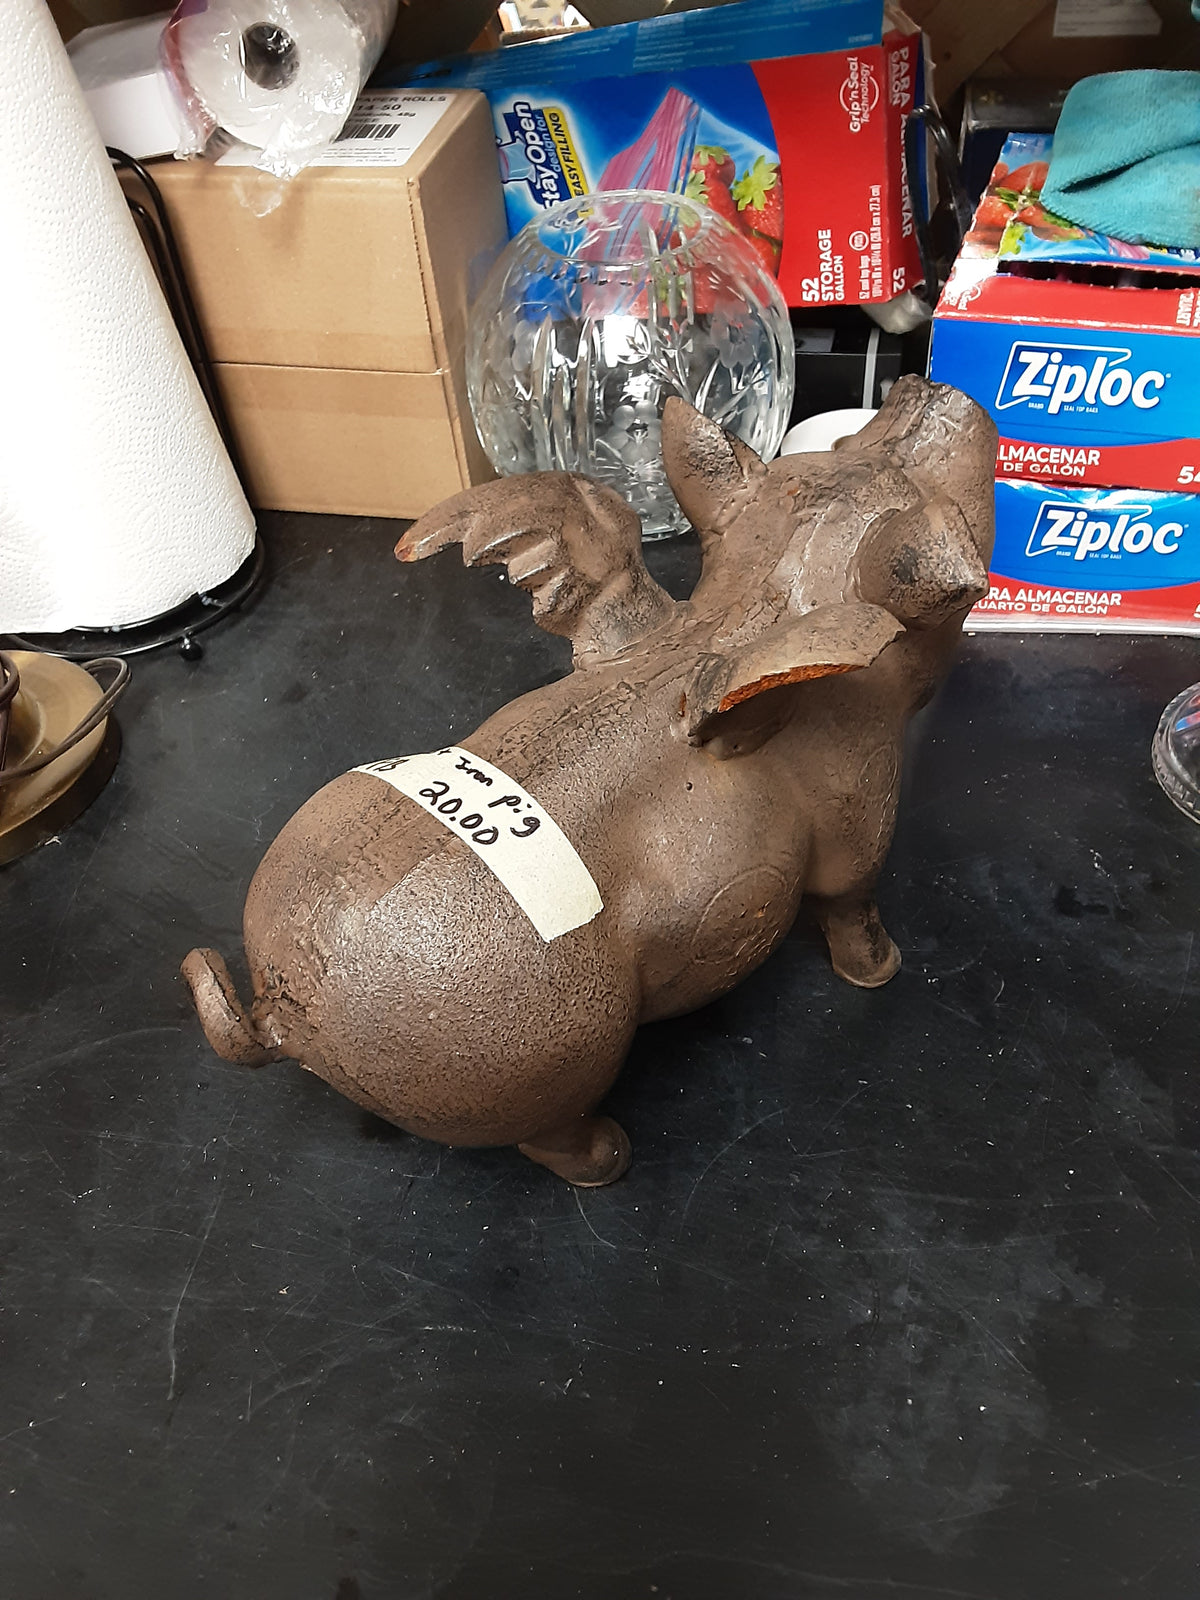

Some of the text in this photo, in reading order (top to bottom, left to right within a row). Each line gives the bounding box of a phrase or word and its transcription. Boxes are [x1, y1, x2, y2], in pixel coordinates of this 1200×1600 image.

[847, 56, 859, 90] Seal
[899, 46, 909, 107] PARA
[859, 62, 871, 124] Technology
[535, 114, 547, 132] for
[549, 112, 575, 164] FILLING
[566, 164, 585, 197] EASY
[818, 229, 834, 302] STORAGE
[834, 255, 845, 301] GALLON
[893, 267, 905, 293] 52
[802, 278, 819, 302] 52
[859, 291, 870, 300] 52
[1176, 292, 1195, 326] QUART
[1012, 351, 1166, 414] Ziploc
[996, 444, 1101, 466] LMACENAR
[1003, 461, 1086, 477] DE GALÓN
[1041, 508, 1184, 561] Ziploc
[984, 586, 1122, 606] RA ALMACENAR
[1031, 603, 1050, 612] DE
[1055, 603, 1108, 615] GALÓN
[418, 780, 499, 845] 20.00
